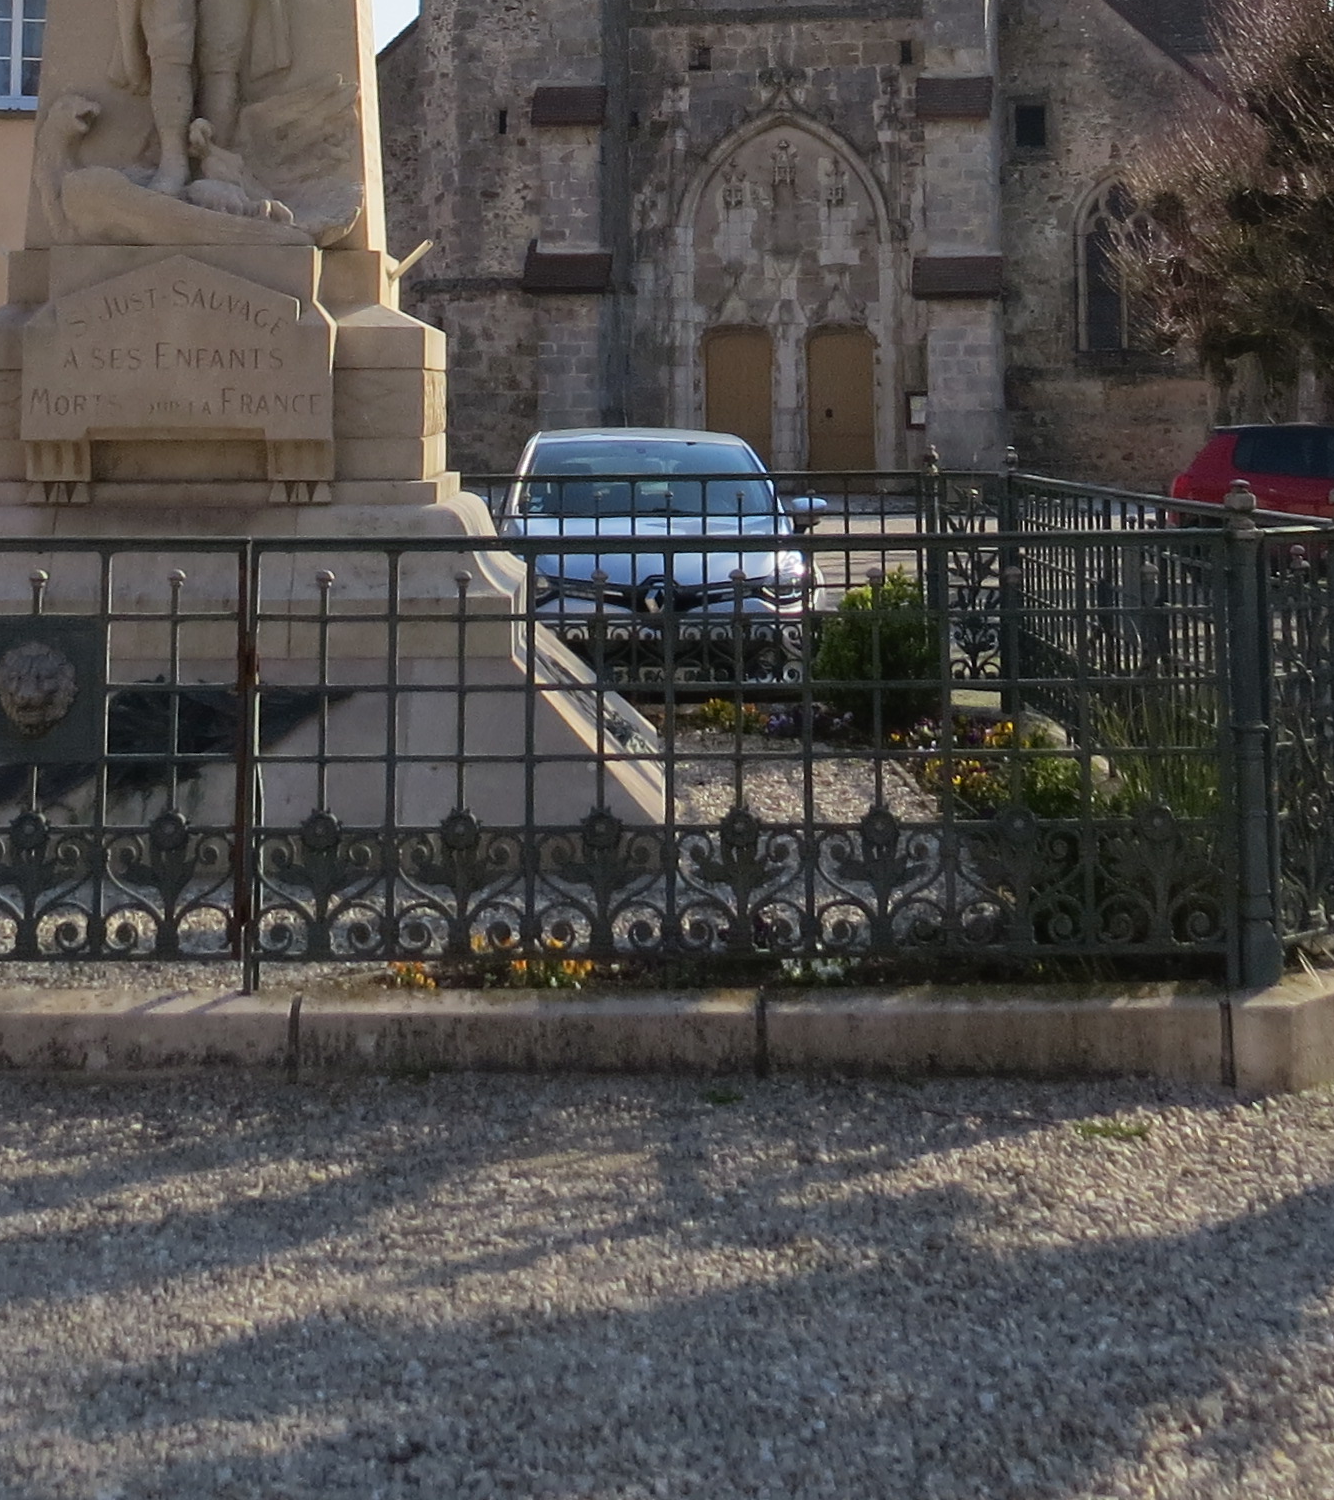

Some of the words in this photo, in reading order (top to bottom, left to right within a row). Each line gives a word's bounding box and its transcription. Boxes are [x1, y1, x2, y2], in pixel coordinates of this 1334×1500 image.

[91, 348, 142, 371] SES
[155, 342, 284, 371] ENFANTS
[221, 388, 322, 416] FRANCE
